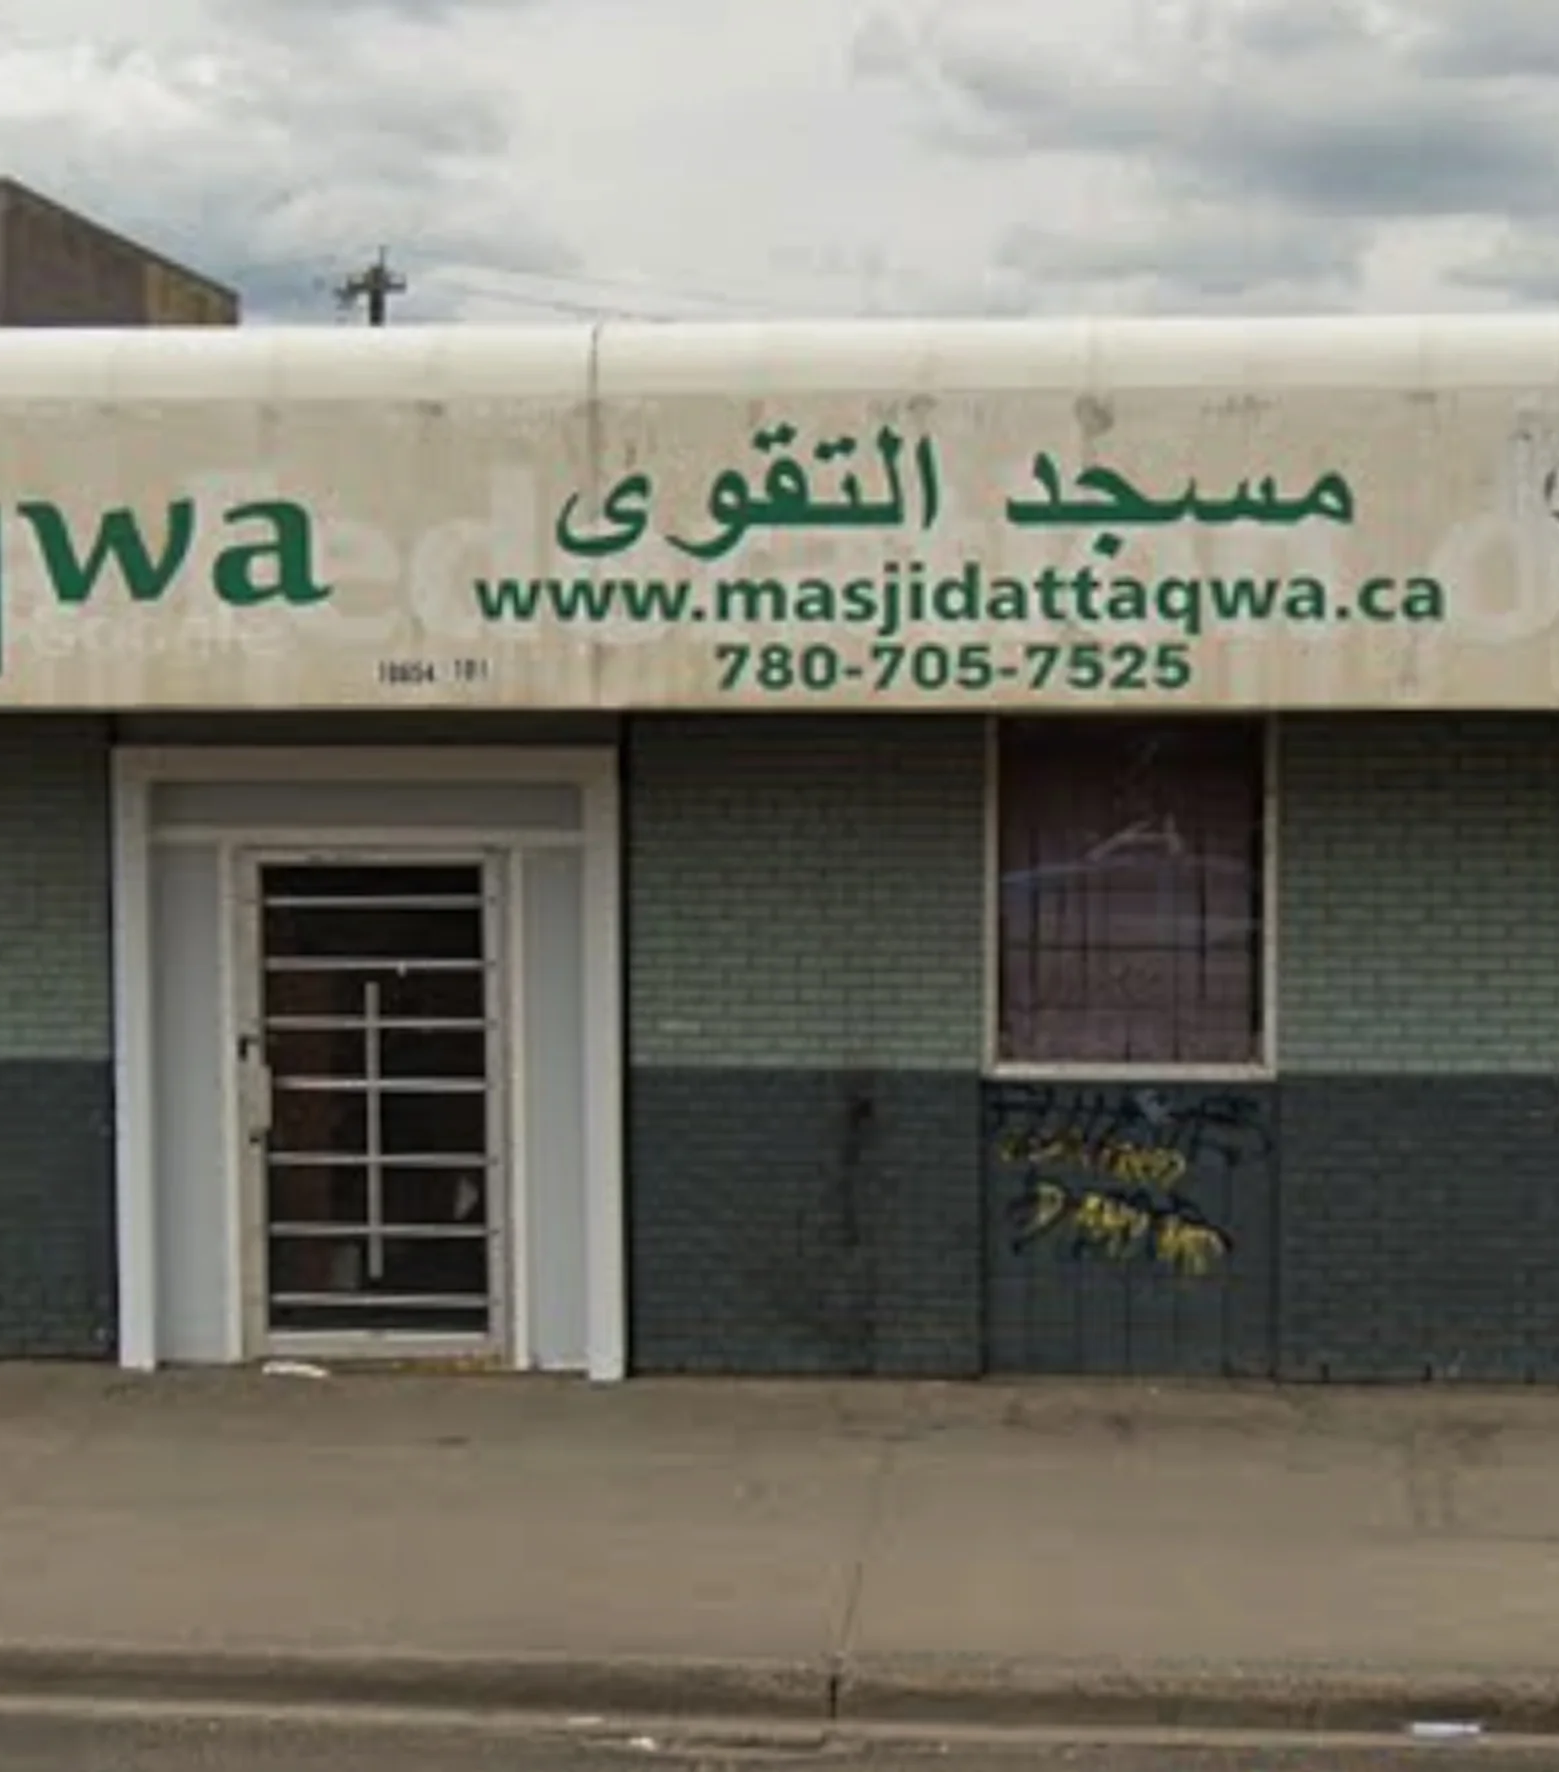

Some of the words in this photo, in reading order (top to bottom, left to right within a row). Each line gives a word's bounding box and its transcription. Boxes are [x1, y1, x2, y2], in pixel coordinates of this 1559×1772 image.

[1005, 452, 1354, 561] مسجد
[473, 562, 1445, 636] www.masjidattaqwa.ca
[715, 641, 1193, 691] 780-705-7525
